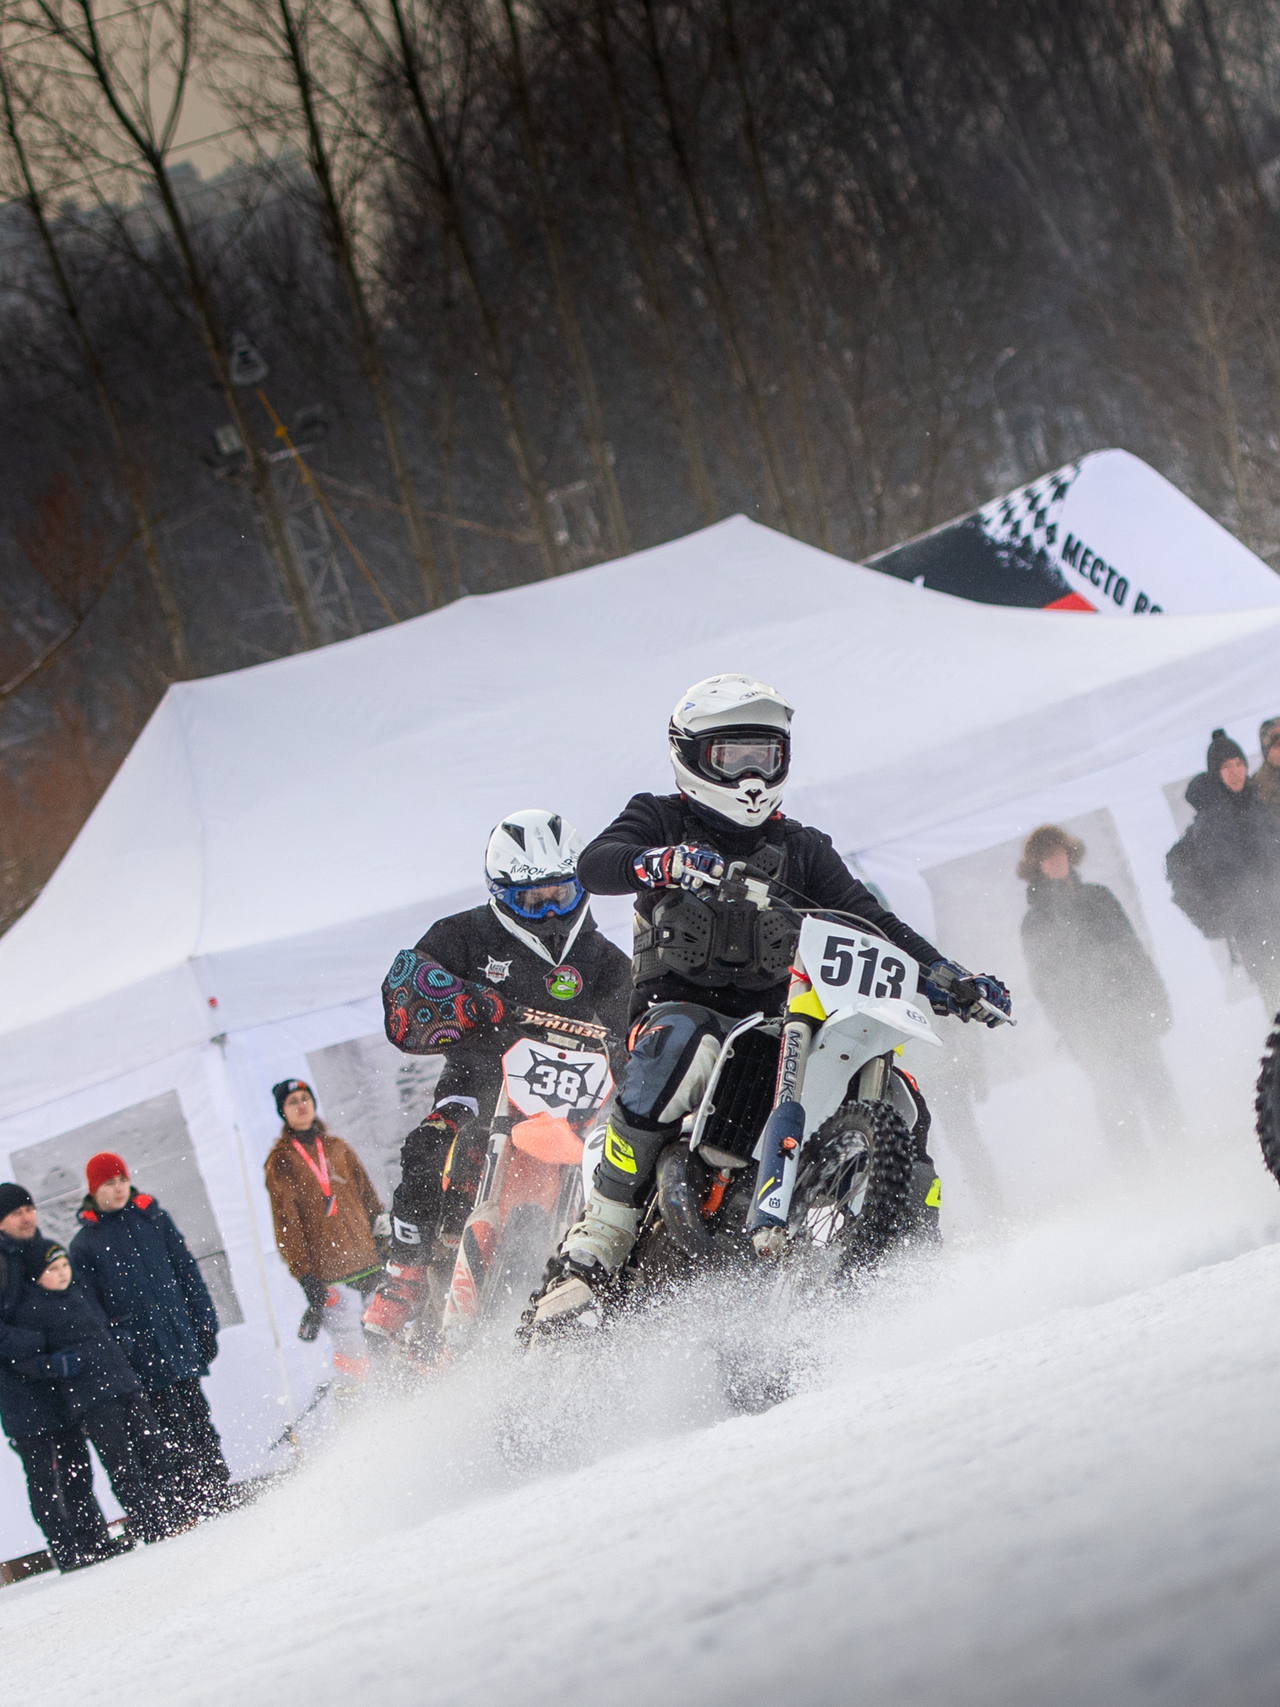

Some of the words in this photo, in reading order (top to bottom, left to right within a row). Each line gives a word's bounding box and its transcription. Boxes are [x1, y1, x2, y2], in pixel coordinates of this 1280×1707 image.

[1061, 531, 1130, 607] МЕСТО
[820, 935, 906, 1000] 513
[519, 1012, 608, 1040] RENTHAL
[532, 1065, 582, 1107] 38
